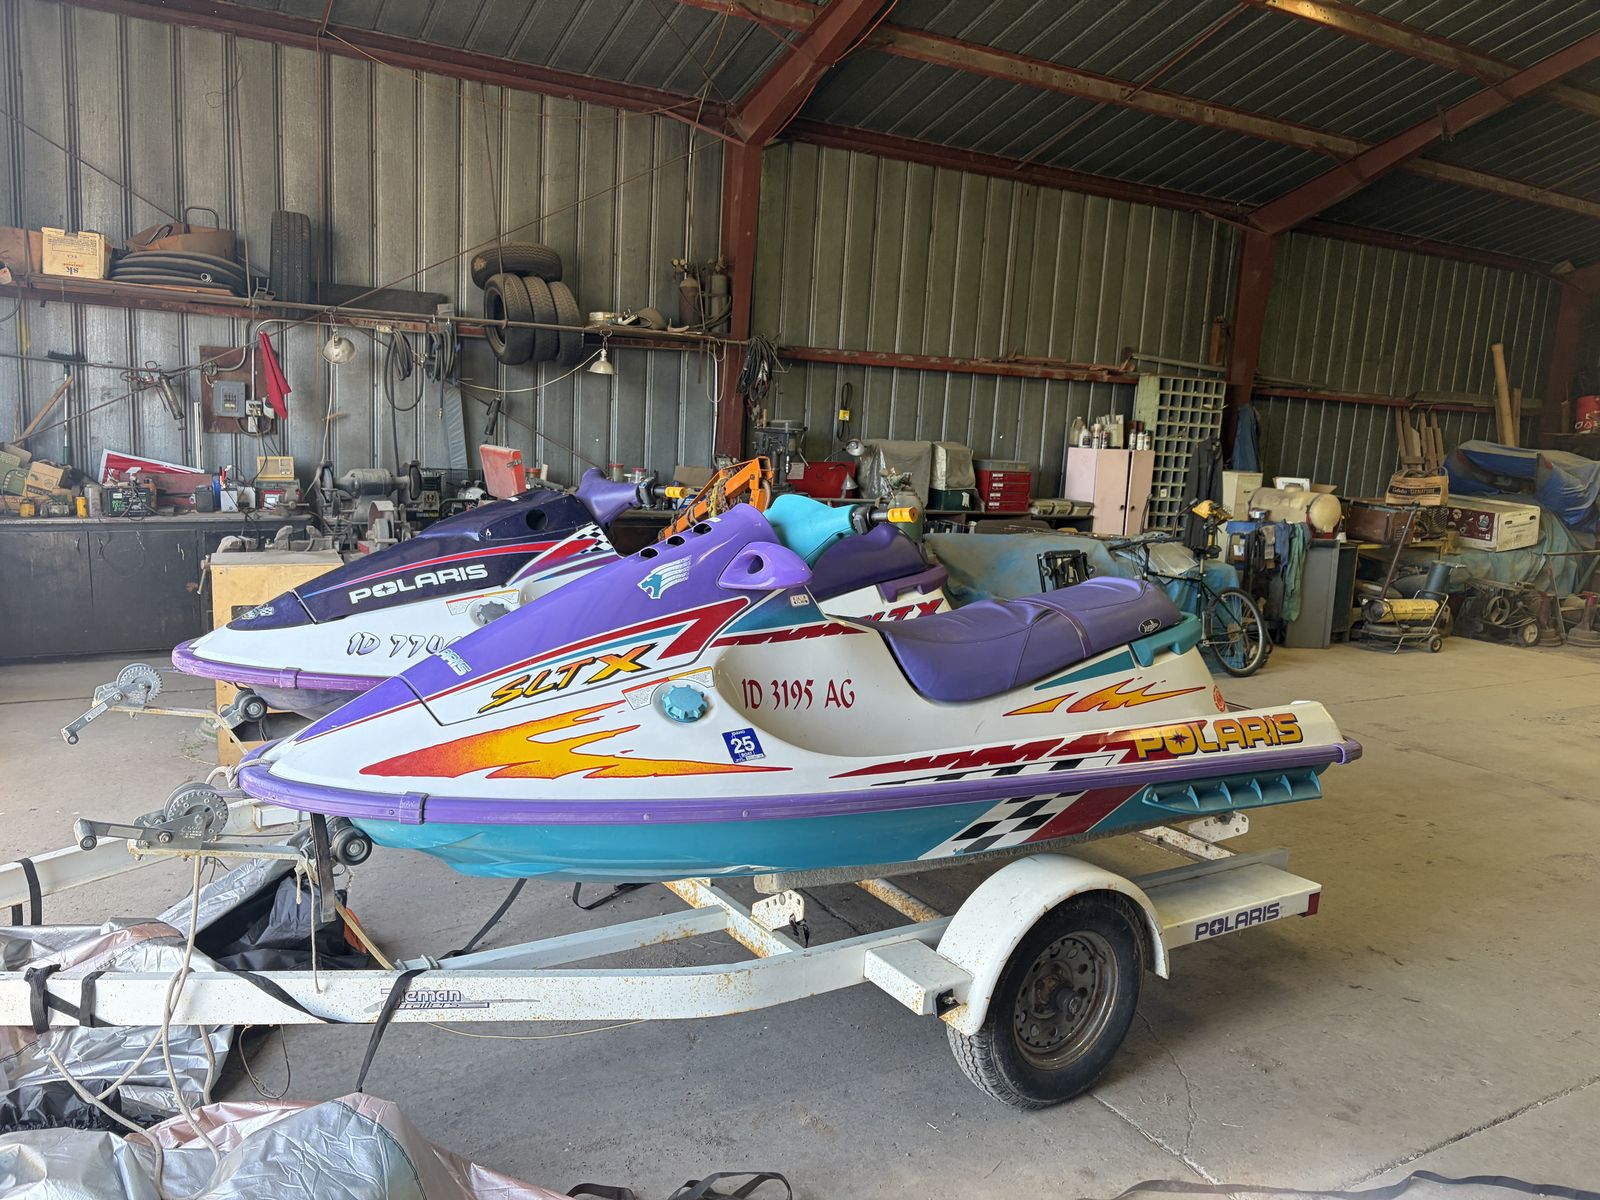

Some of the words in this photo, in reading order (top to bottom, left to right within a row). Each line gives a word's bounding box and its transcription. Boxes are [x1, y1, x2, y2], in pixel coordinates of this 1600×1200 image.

[348, 563, 489, 605] POLARIS
[346, 631, 381, 656] ID
[477, 642, 659, 714] SLTX
[741, 678, 763, 710] ID
[770, 679, 815, 710] 3195
[824, 678, 855, 709] AG
[730, 735, 756, 754] 25
[1136, 712, 1304, 761] POLARIS
[1194, 902, 1281, 941] POLARIS
